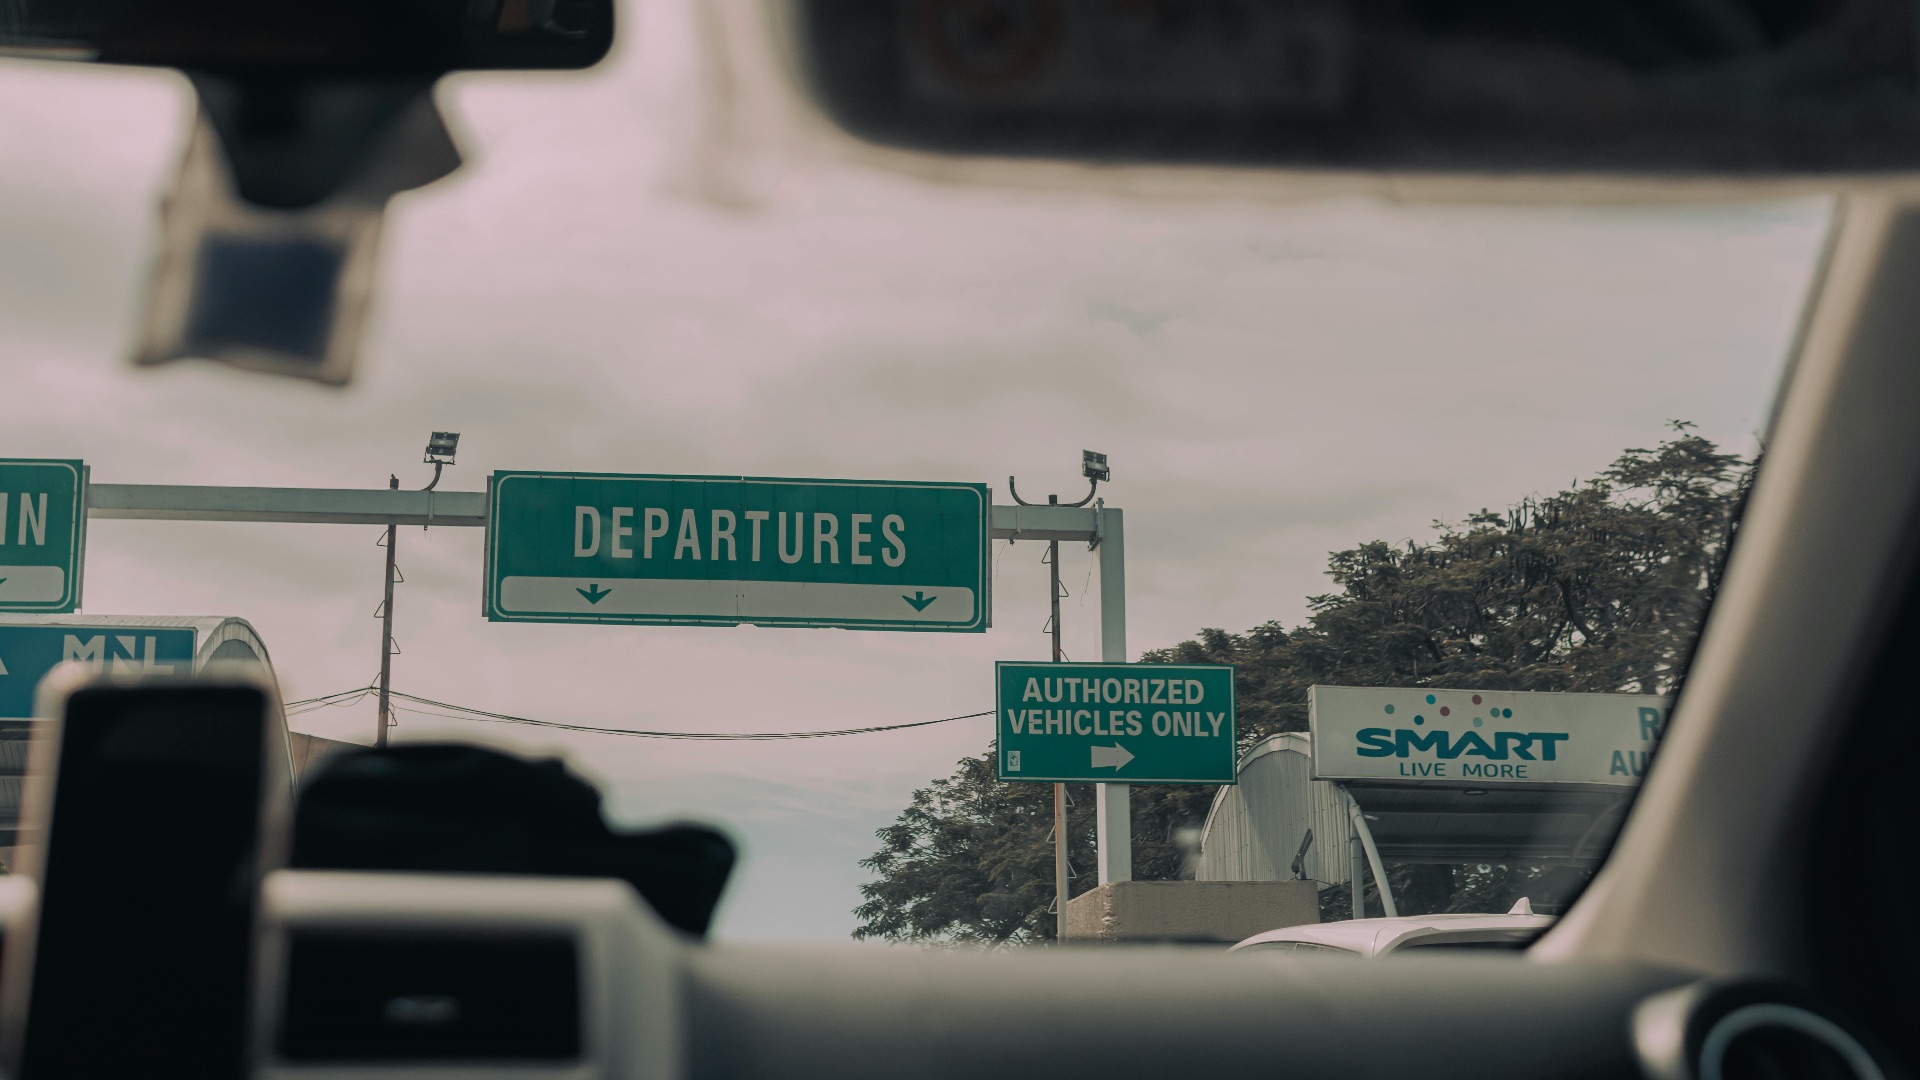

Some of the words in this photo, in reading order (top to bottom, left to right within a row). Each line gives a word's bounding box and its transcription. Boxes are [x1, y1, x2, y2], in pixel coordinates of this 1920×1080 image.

[573, 505, 906, 567] DEPARTURES
[62, 634, 175, 675] MNL
[1022, 677, 1204, 705] AUTHORIZED
[1008, 708, 1143, 736] VEHICLES
[1151, 711, 1225, 737] ONLY
[1355, 727, 1569, 761] SMART
[1400, 762, 1446, 777] LIVE
[1462, 763, 1528, 779] MORE
